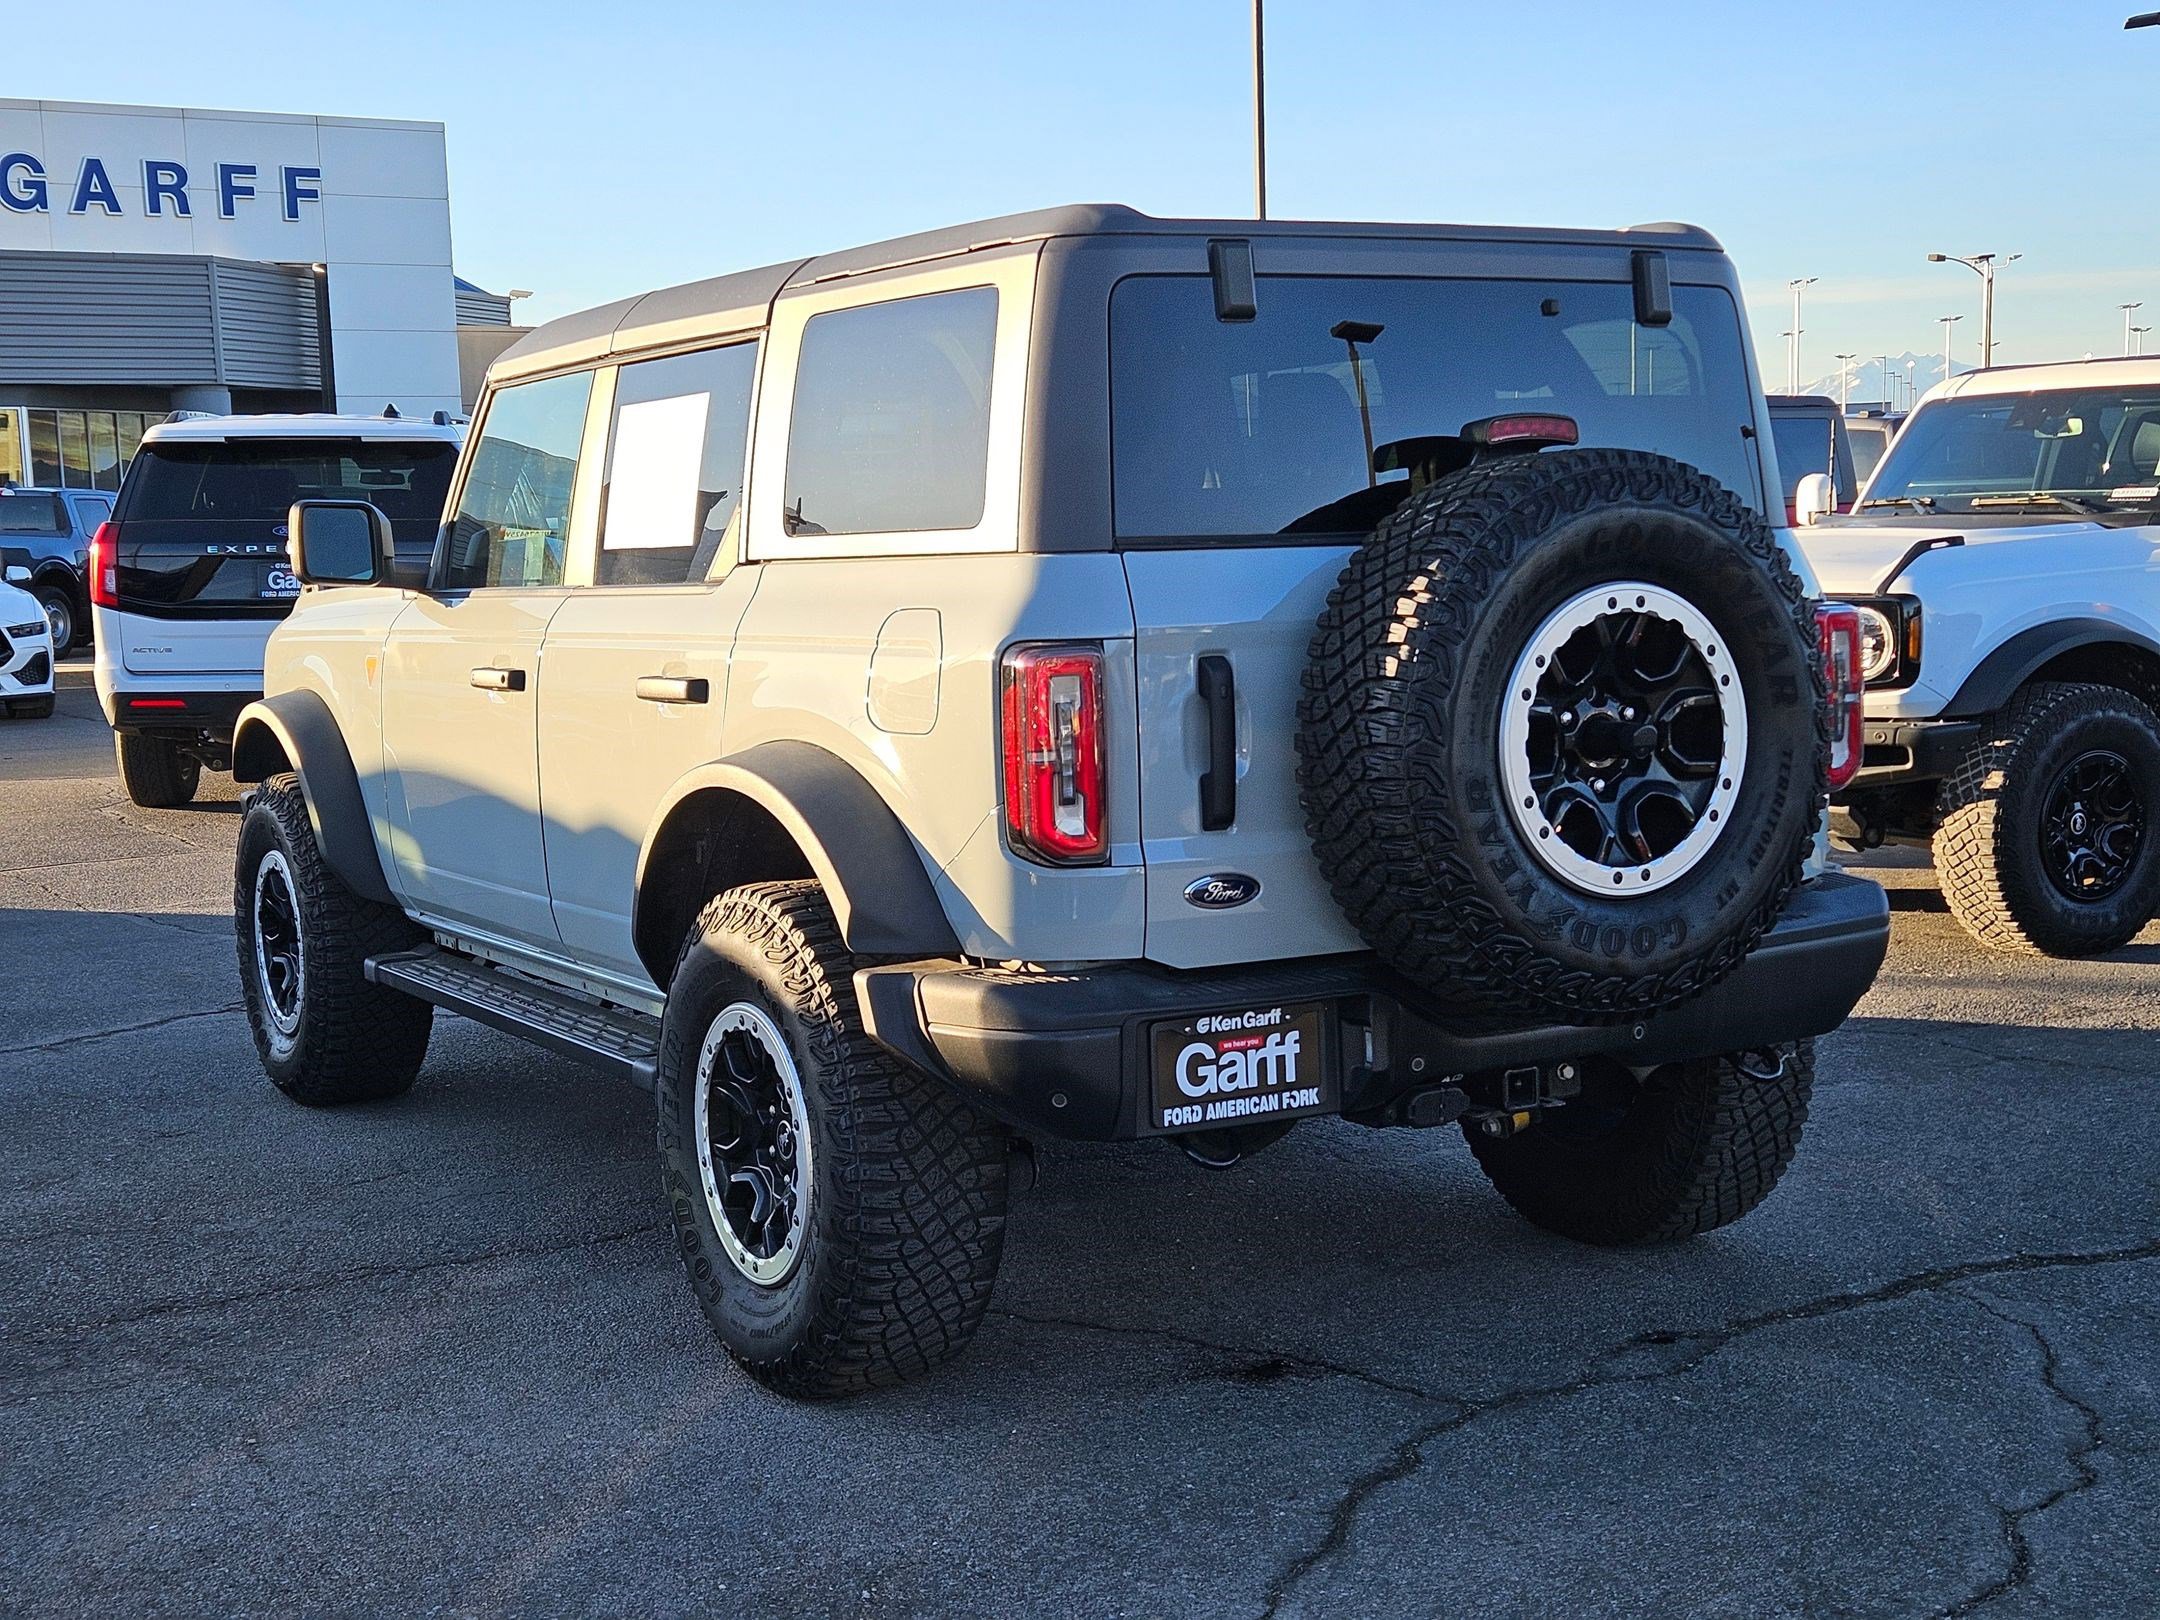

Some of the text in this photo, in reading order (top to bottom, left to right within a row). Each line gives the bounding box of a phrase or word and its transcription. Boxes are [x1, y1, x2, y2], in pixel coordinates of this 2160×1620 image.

[0, 151, 322, 222] GARFF
[207, 545, 287, 553] EXPE
[1203, 881, 1245, 901] Ford
[1466, 774, 1688, 958] GOODYEAR
[1175, 1030, 1300, 1097] Garff
[1163, 1088, 1319, 1127] FORD AMERICAN FORK
[657, 1029, 723, 1308] GOODYEAR
